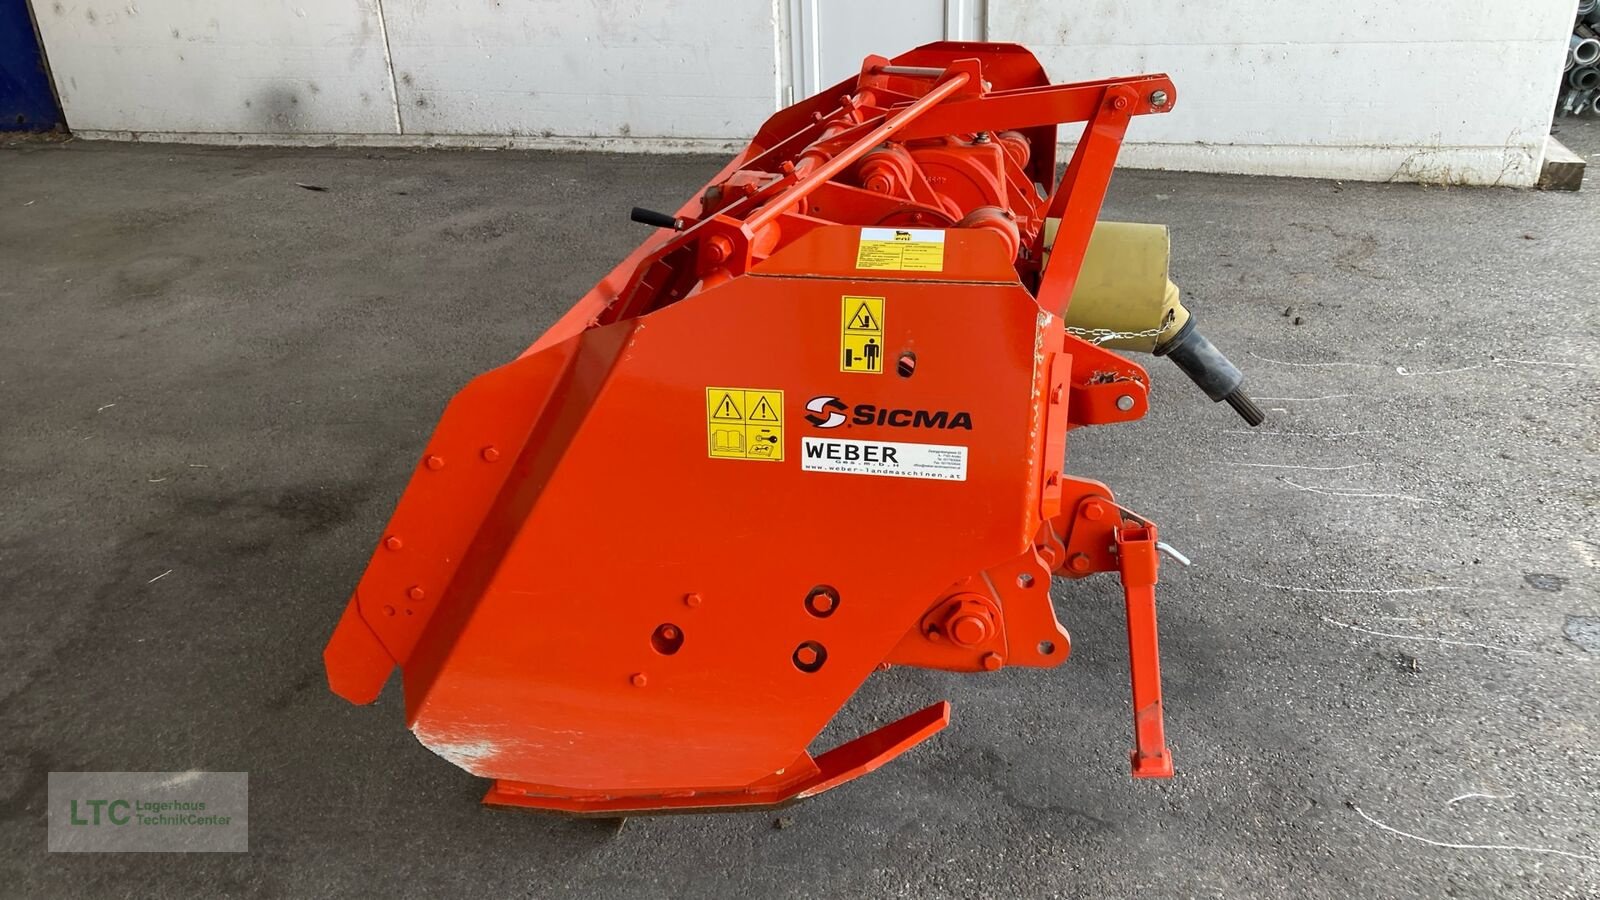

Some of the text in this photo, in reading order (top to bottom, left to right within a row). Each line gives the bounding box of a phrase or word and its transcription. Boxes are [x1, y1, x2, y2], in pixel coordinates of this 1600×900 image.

[852, 404, 972, 430] SICMA
[805, 442, 899, 463] WEBER
[805, 464, 961, 479] www.weber-landmaschinen.at
